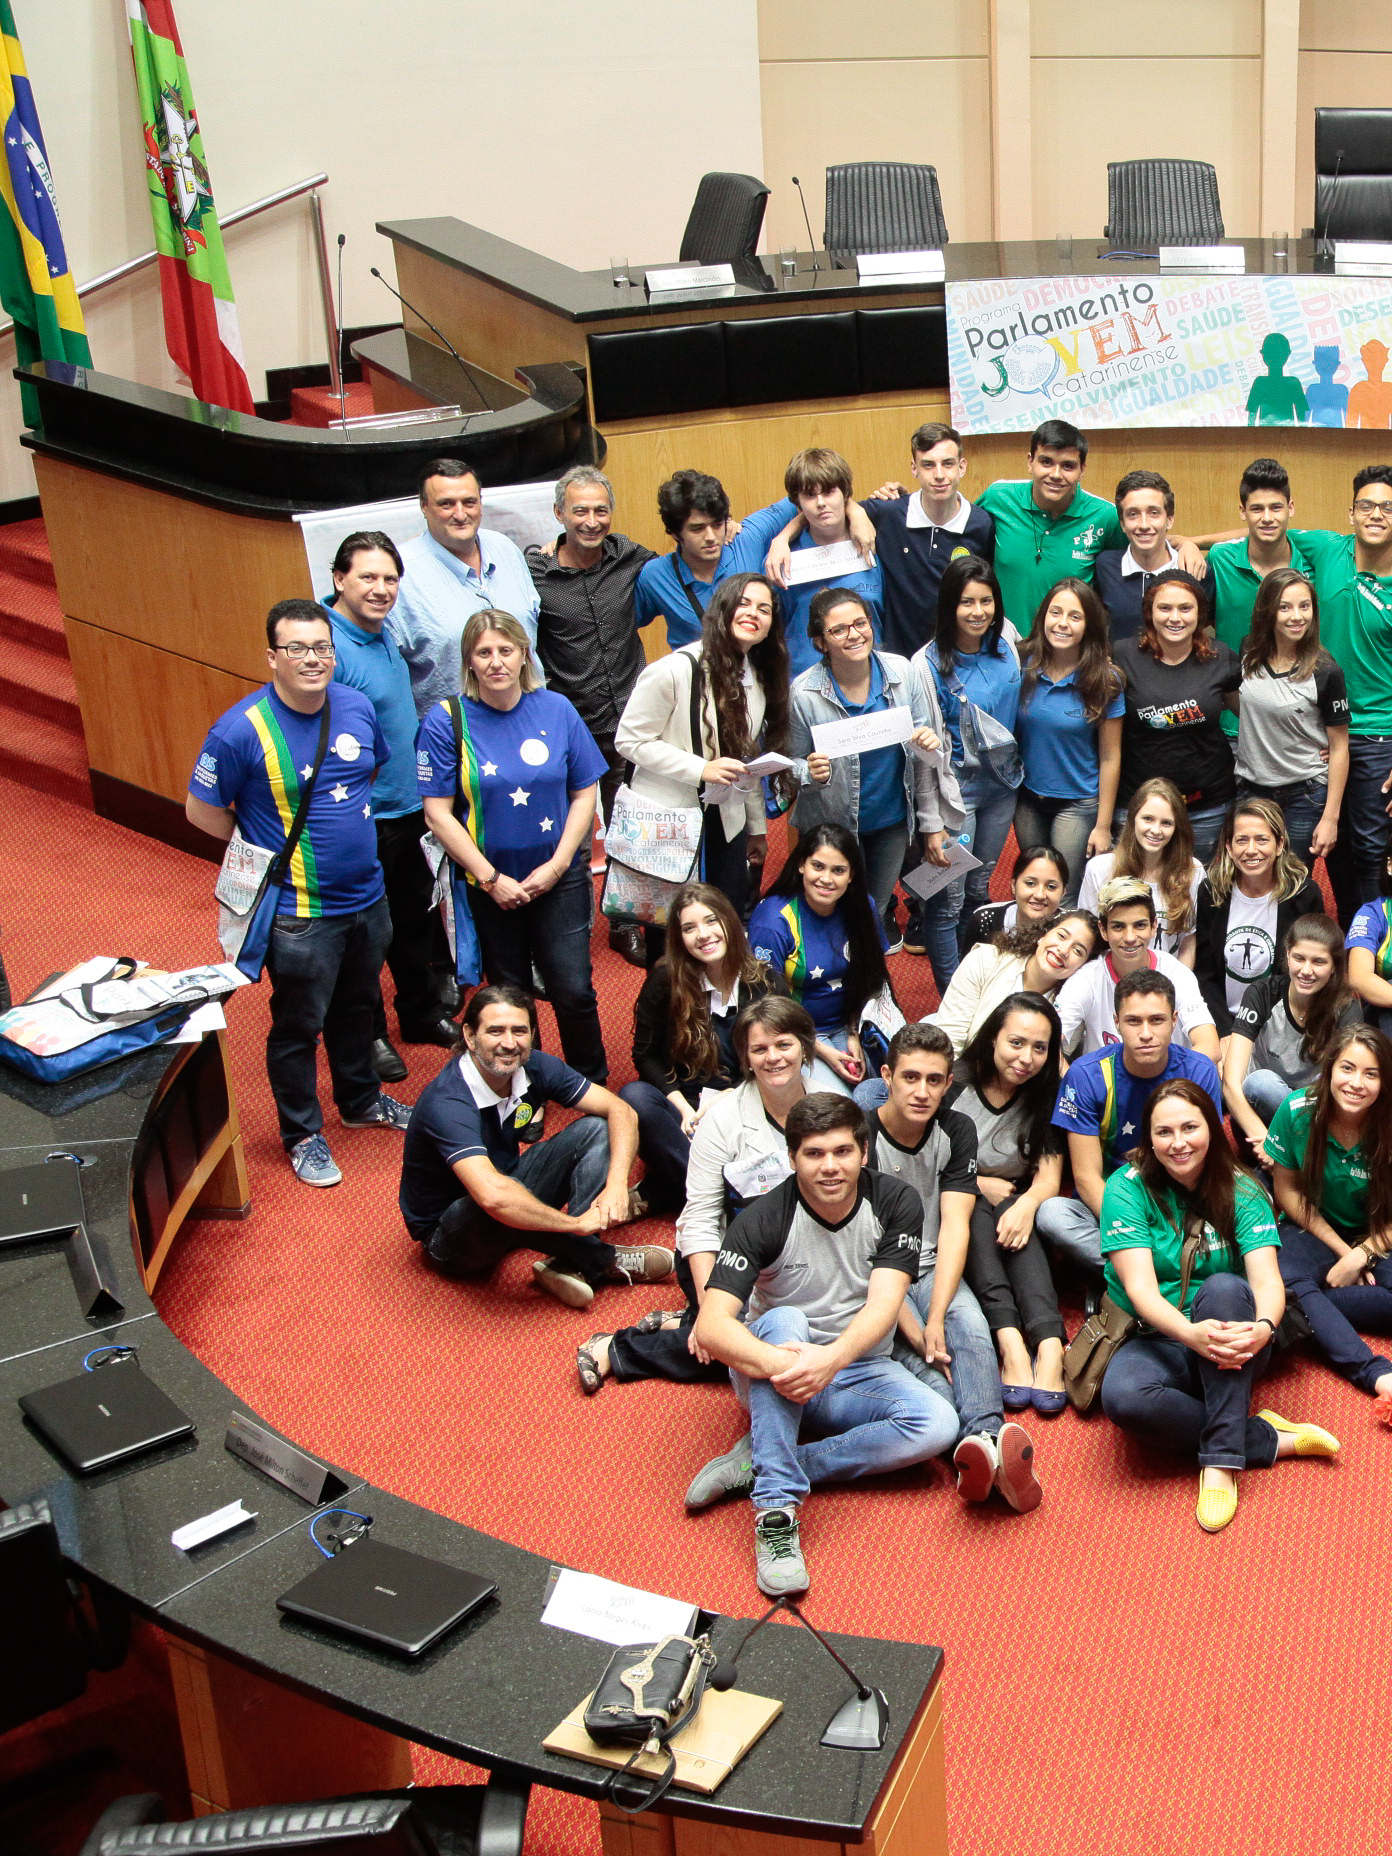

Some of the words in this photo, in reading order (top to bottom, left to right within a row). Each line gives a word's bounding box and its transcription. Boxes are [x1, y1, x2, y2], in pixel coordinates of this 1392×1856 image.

[960, 302, 1021, 329] Programa
[1165, 281, 1241, 318] DEBATE
[965, 282, 1153, 358] Parlamento
[1177, 302, 1247, 340] SAÚDE
[981, 303, 1173, 401] JOVEM
[1184, 325, 1256, 371] LEIS
[1052, 345, 1179, 397] catarinense
[1109, 362, 1234, 420] IGUALDADE
[1138, 699, 1198, 720] Parlamento
[617, 805, 687, 823] Parlamento
[717, 1249, 749, 1272] PMO
